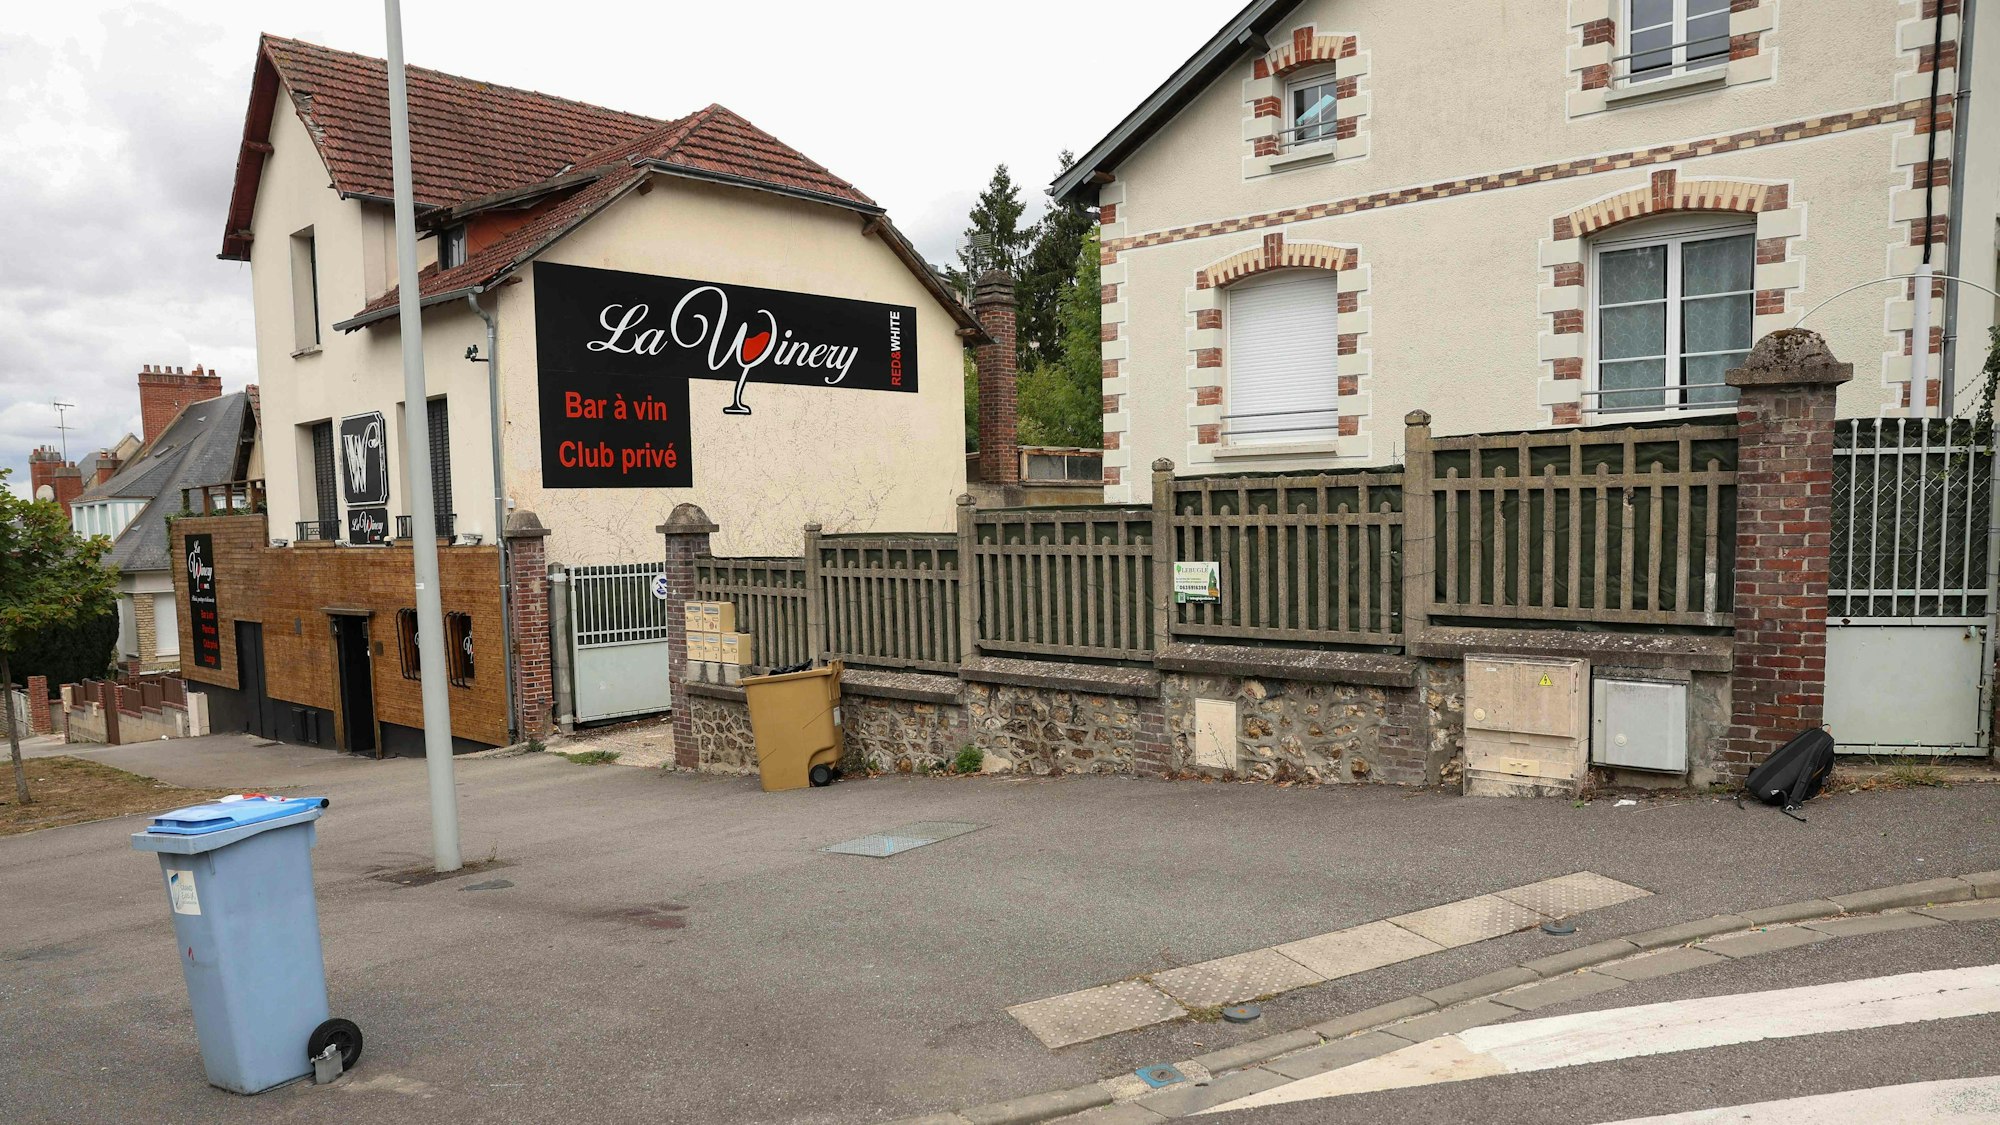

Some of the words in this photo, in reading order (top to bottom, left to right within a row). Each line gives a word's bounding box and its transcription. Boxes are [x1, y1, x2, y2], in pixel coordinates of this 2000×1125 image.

[586, 303, 668, 356] La
[670, 286, 859, 386] Winery
[889, 310, 902, 386] RED&WHITE
[565, 391, 607, 418] Bar
[613, 393, 627, 420] à
[633, 395, 667, 421] vin
[558, 440, 615, 468] Club
[621, 442, 677, 475] privé
